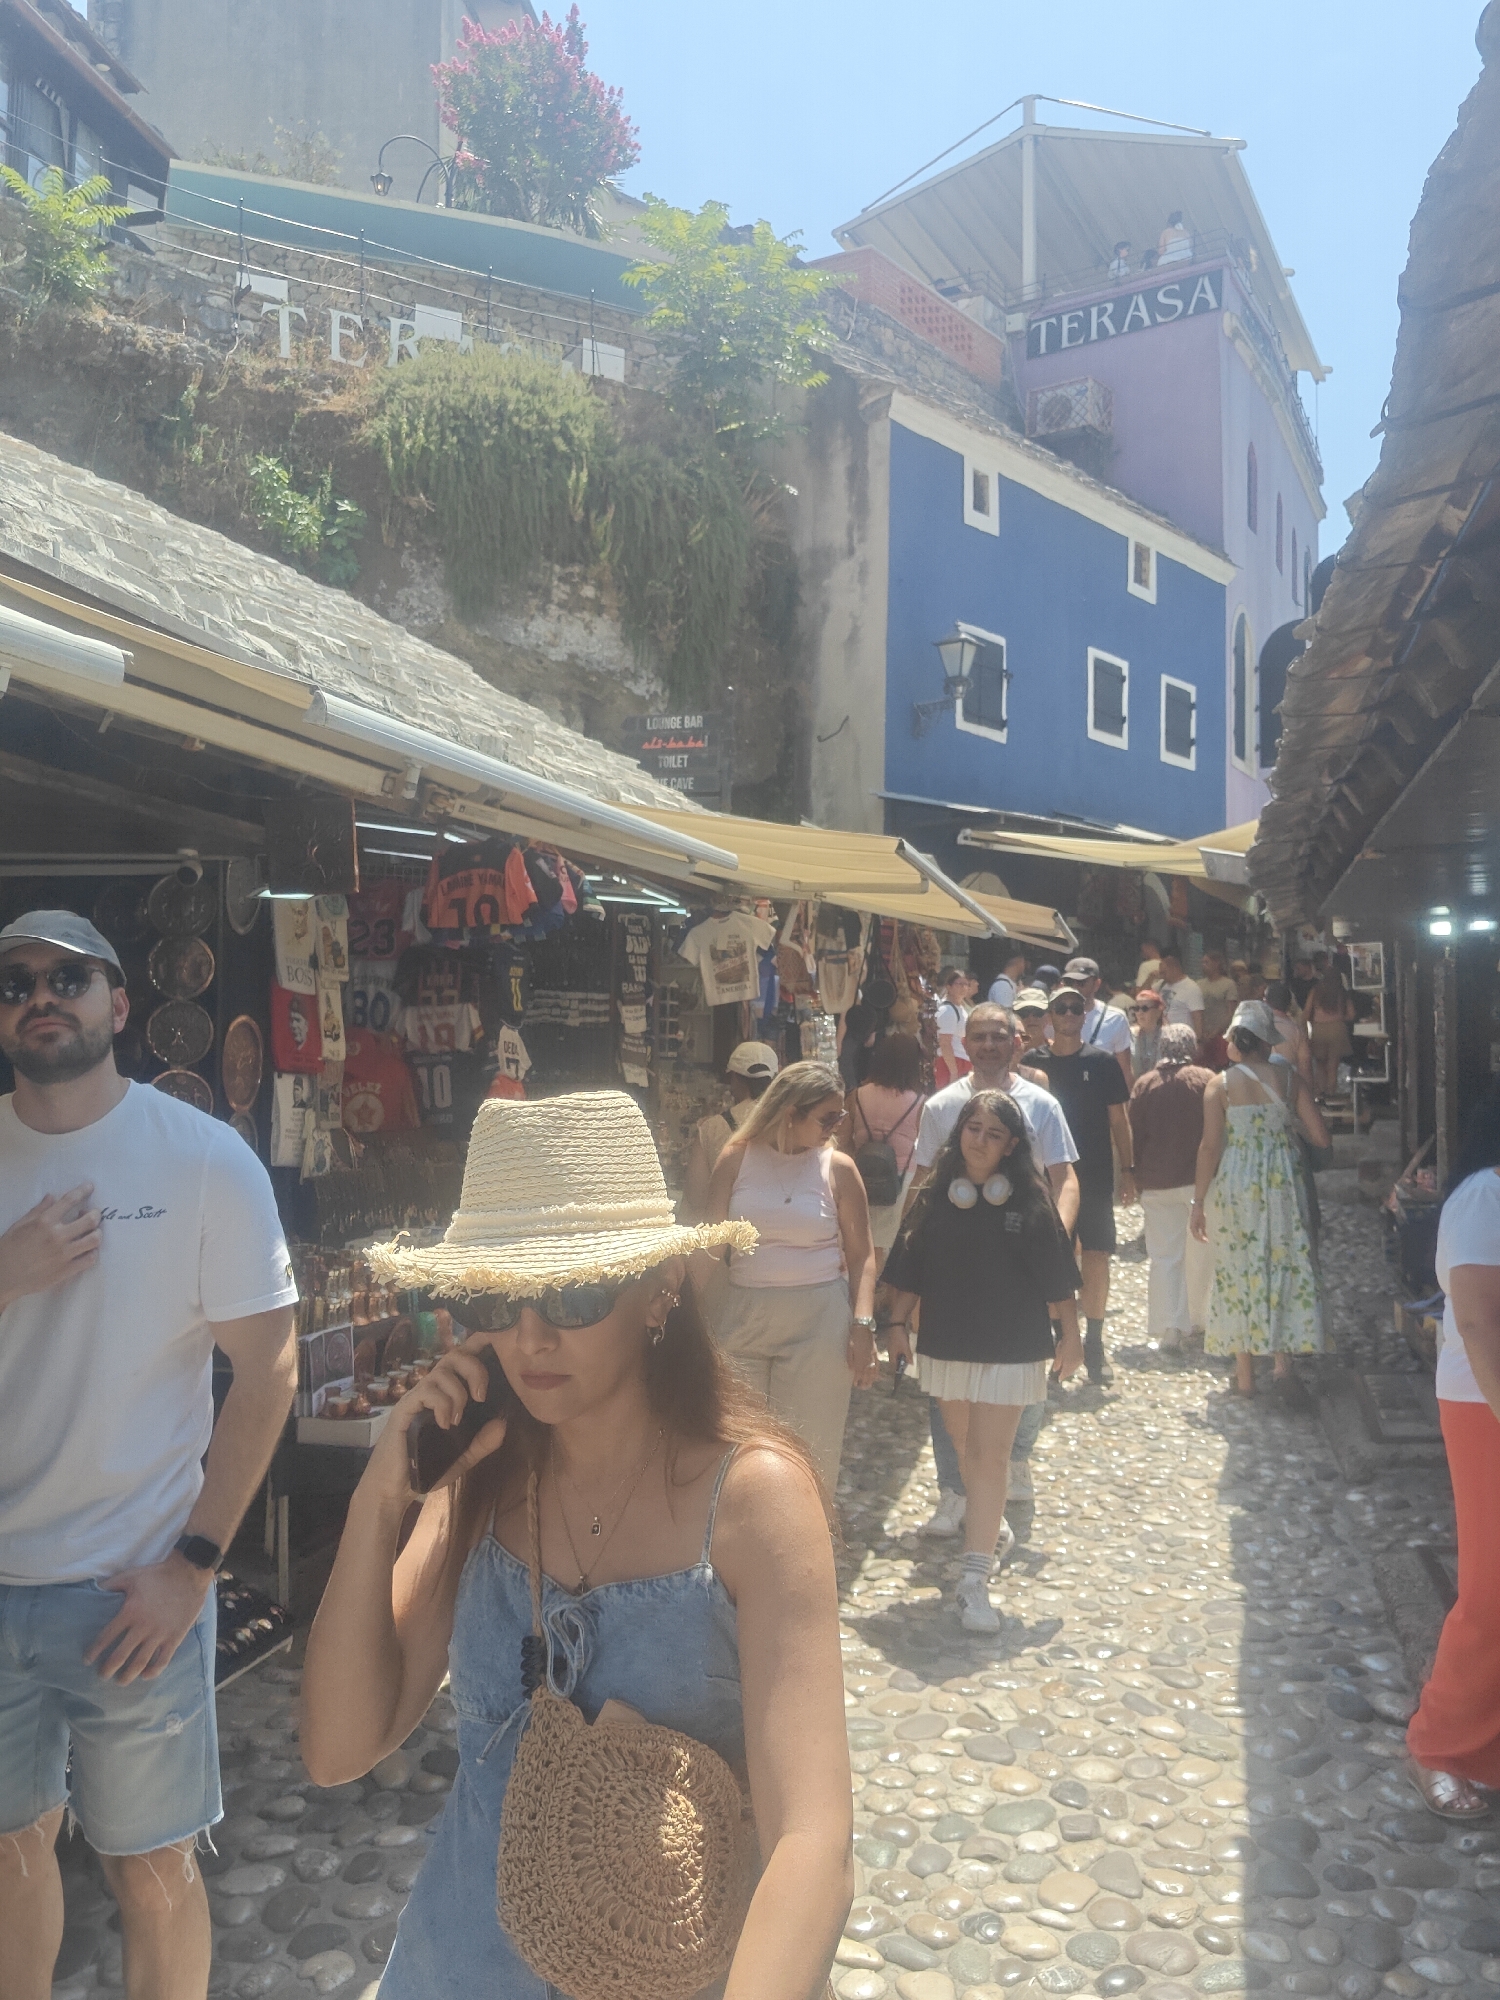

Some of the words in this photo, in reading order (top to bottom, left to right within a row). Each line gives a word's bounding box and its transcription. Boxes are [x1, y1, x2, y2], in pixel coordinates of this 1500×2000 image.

[1030, 275, 1219, 355] TERASA
[647, 717, 682, 730] LOUNGE
[684, 715, 703, 729] BAR
[658, 755, 688, 768] TOILET
[671, 777, 694, 790] CAVE
[448, 894, 499, 927] 10
[349, 919, 395, 955] 23
[286, 965, 312, 986] BOSS
[416, 1064, 453, 1109] 10
[134, 1206, 167, 1220] Scott
